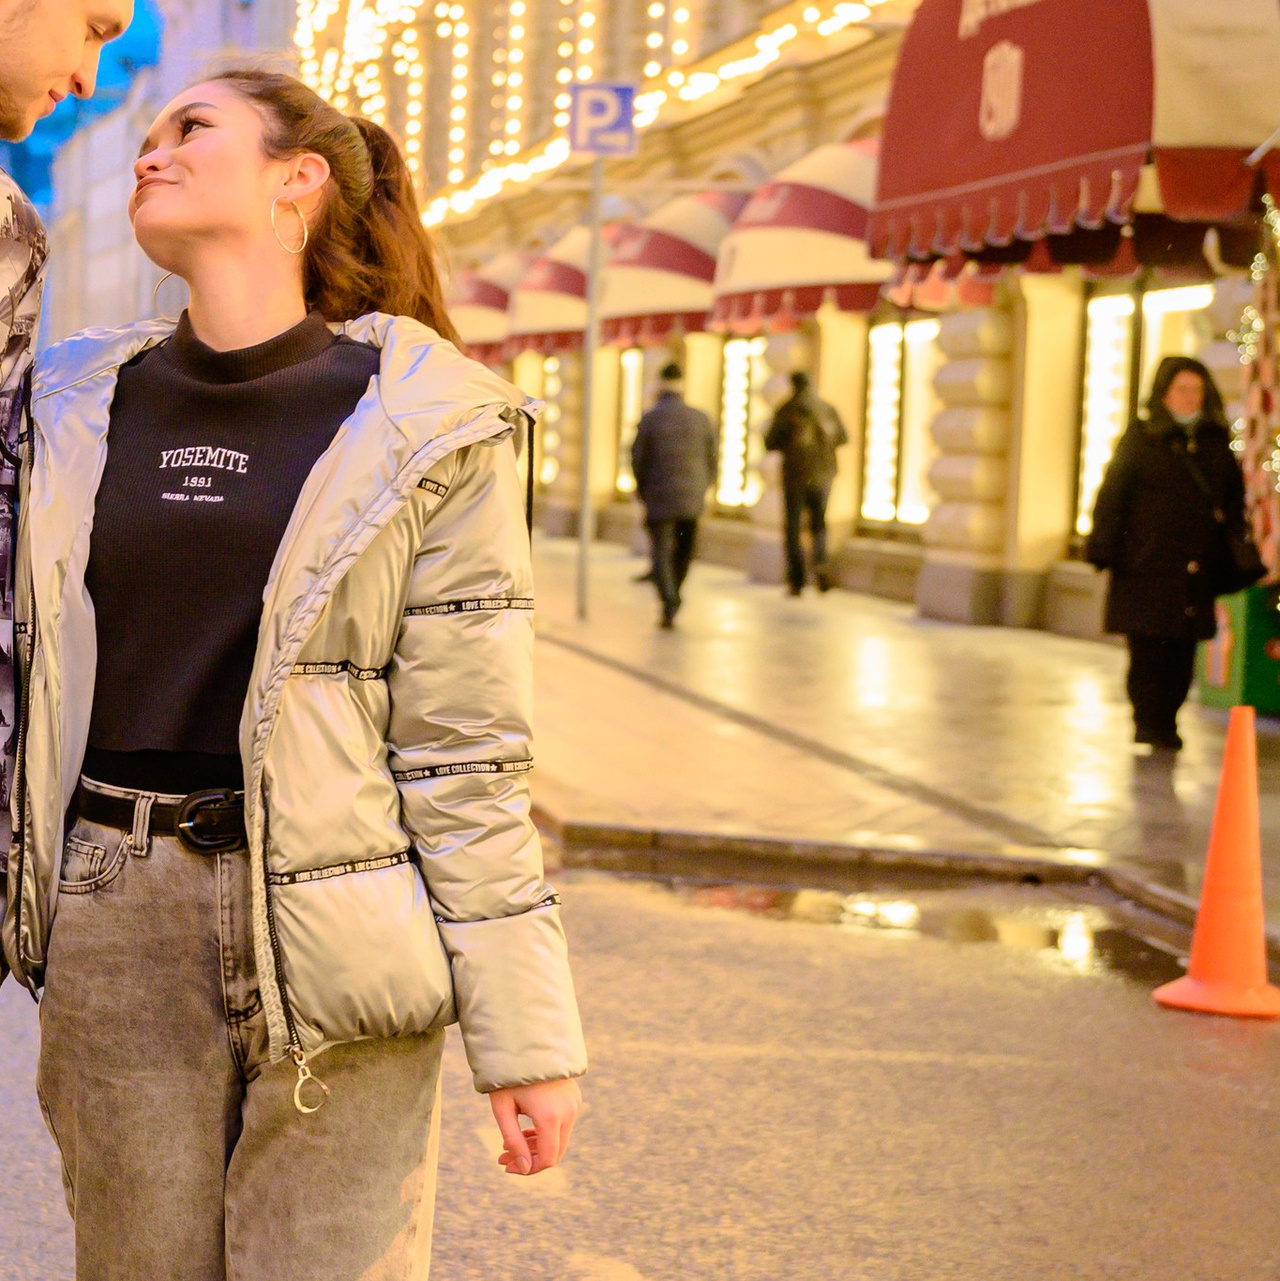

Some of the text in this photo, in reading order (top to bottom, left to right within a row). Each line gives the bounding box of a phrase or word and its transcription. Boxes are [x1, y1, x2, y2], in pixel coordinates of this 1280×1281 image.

[577, 89, 618, 147] P
[158, 446, 250, 473] YOSEMITE
[182, 476, 212, 488] 1991
[161, 492, 190, 501] SIERRA
[462, 601, 479, 610] LOVE
[435, 766, 451, 775] LOVE
[451, 763, 491, 774] COLLECTION
